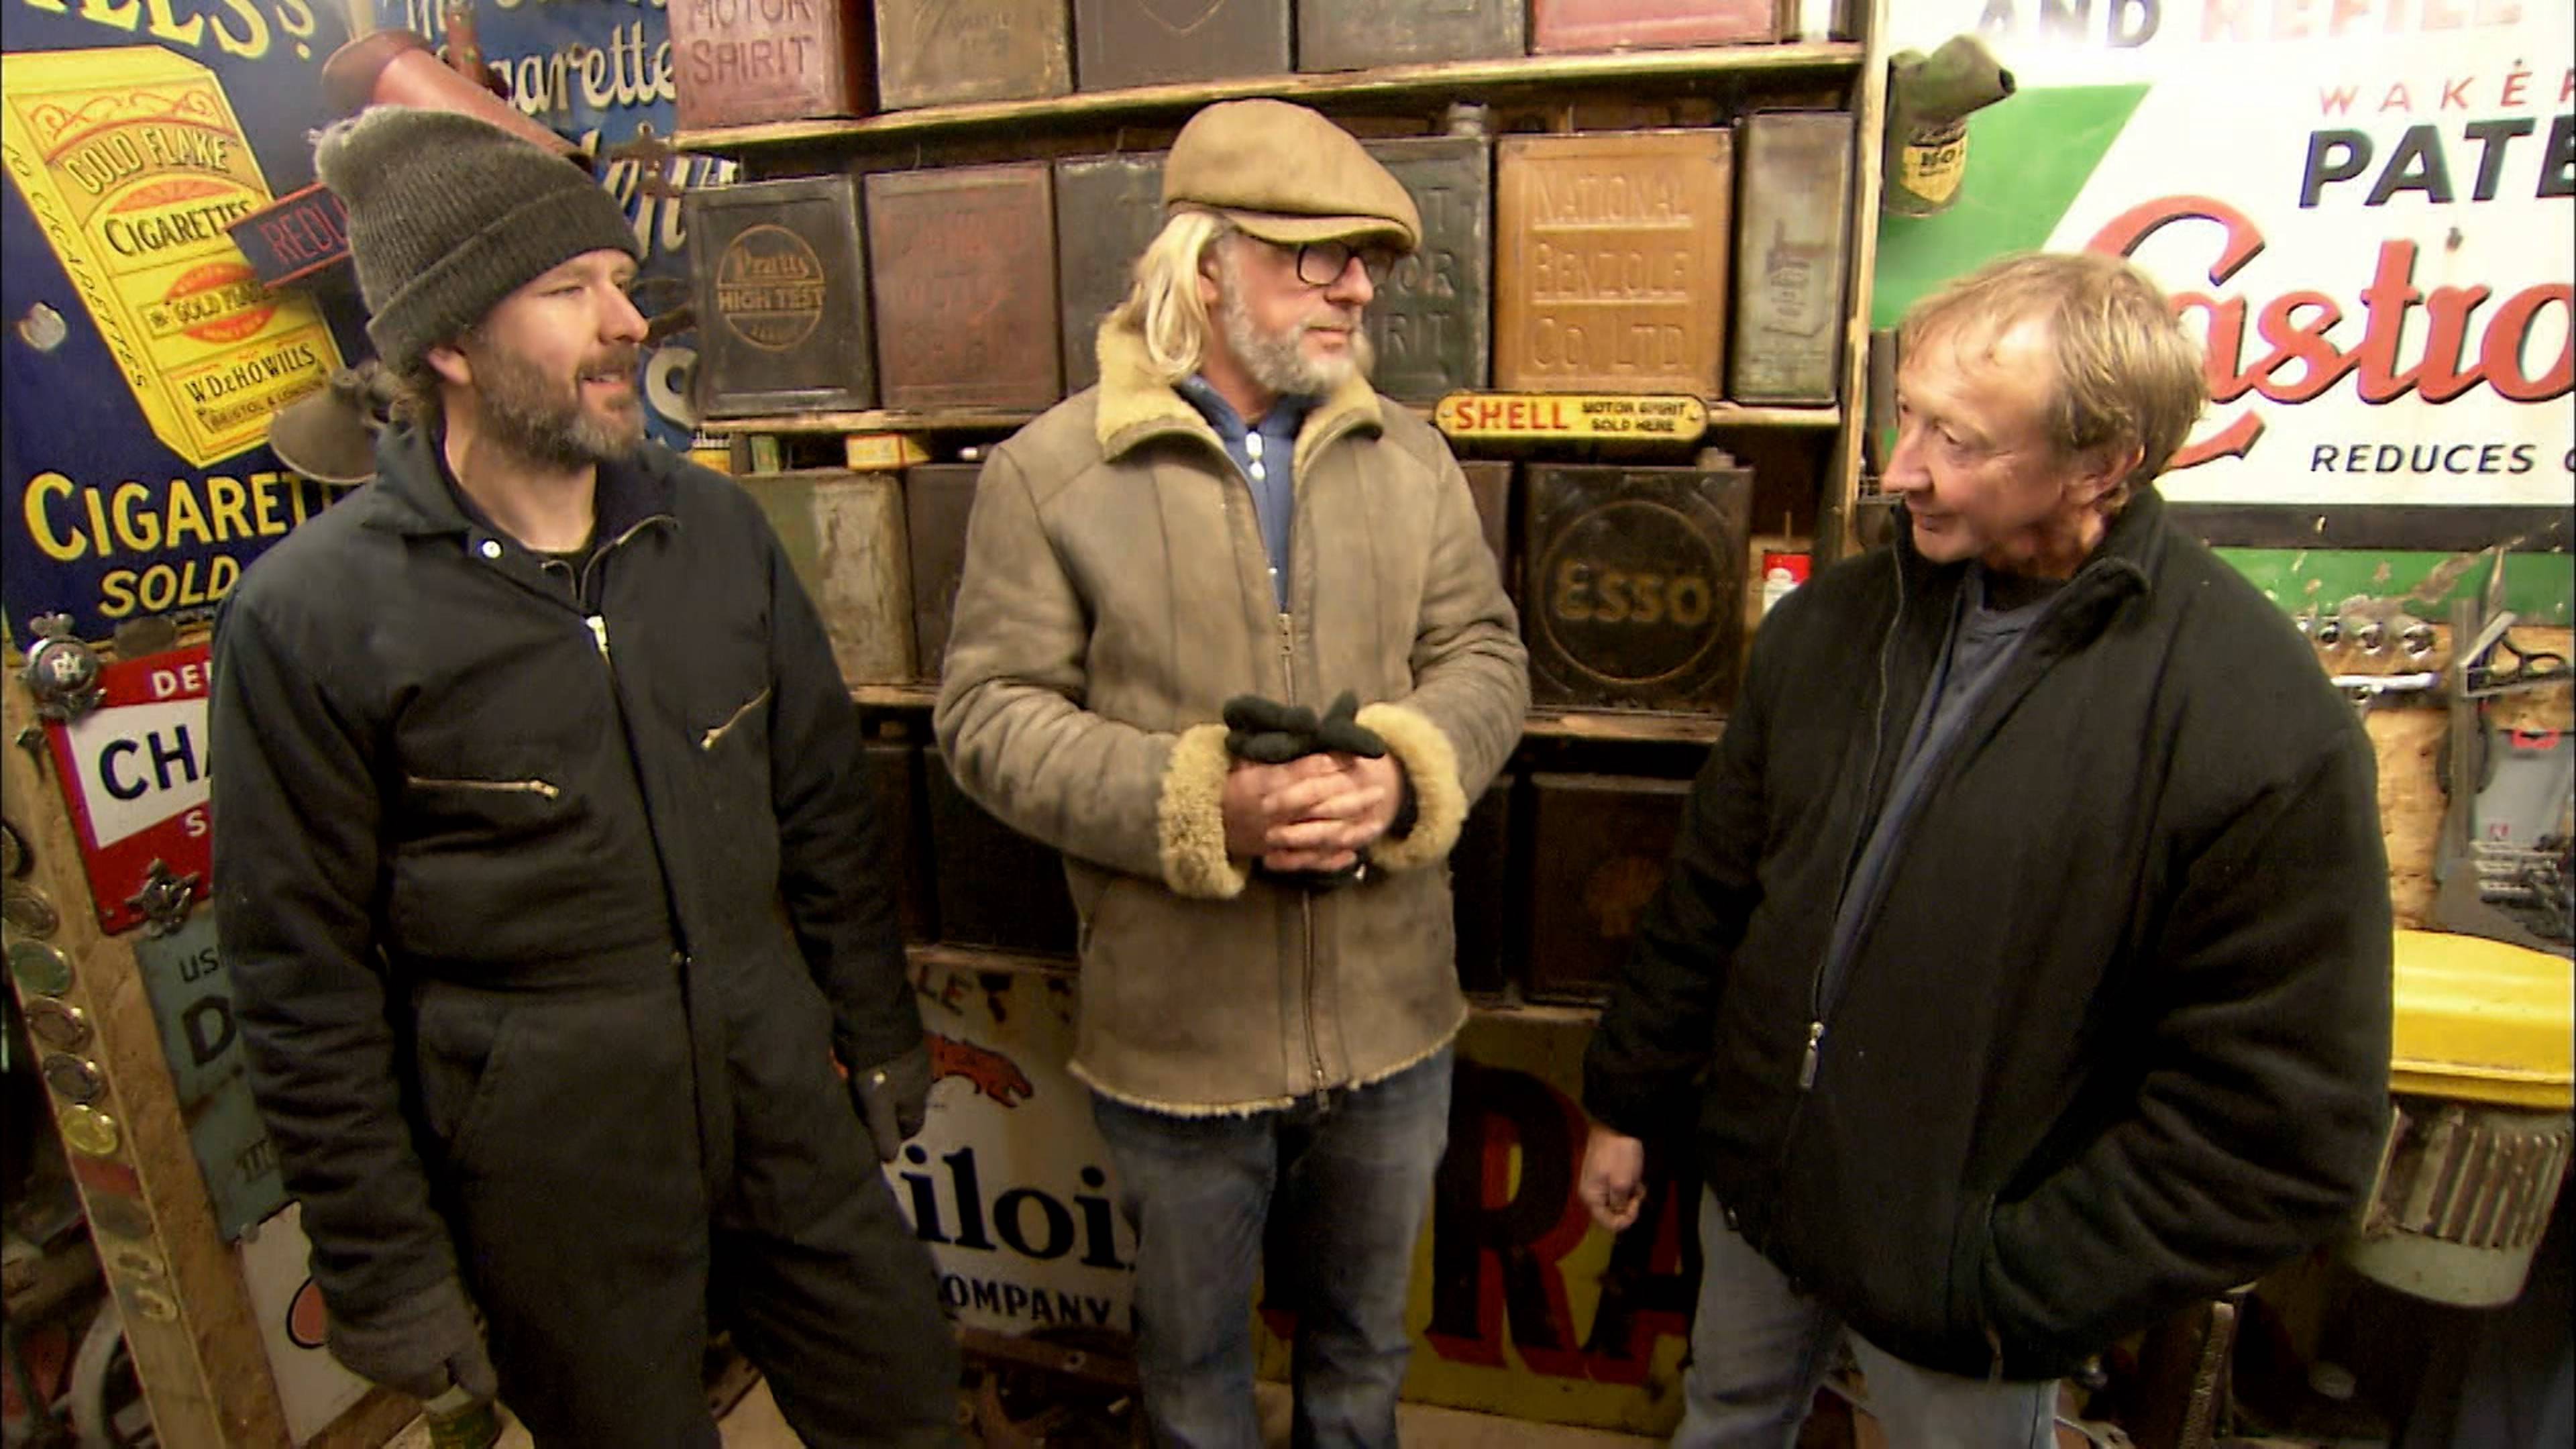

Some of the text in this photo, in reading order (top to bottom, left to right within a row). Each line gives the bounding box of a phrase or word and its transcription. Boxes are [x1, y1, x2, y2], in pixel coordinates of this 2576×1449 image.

[691, 35, 814, 86] SPIRIT
[64, 127, 233, 197] GOLD FLAKE
[1532, 173, 1693, 221] NATIONAL
[1532, 240, 1689, 297] BENZOLE
[1454, 400, 1570, 431] SHELL
[1582, 400, 1633, 415] MOTOR
[1591, 417, 1675, 432] SOLD HERE
[2310, 443, 2536, 474] REDUCES
[99, 554, 241, 618] SOLD
[1554, 558, 1712, 625] ESSO
[99, 724, 211, 801] CH
[939, 1273, 1112, 1328] OMPANY
